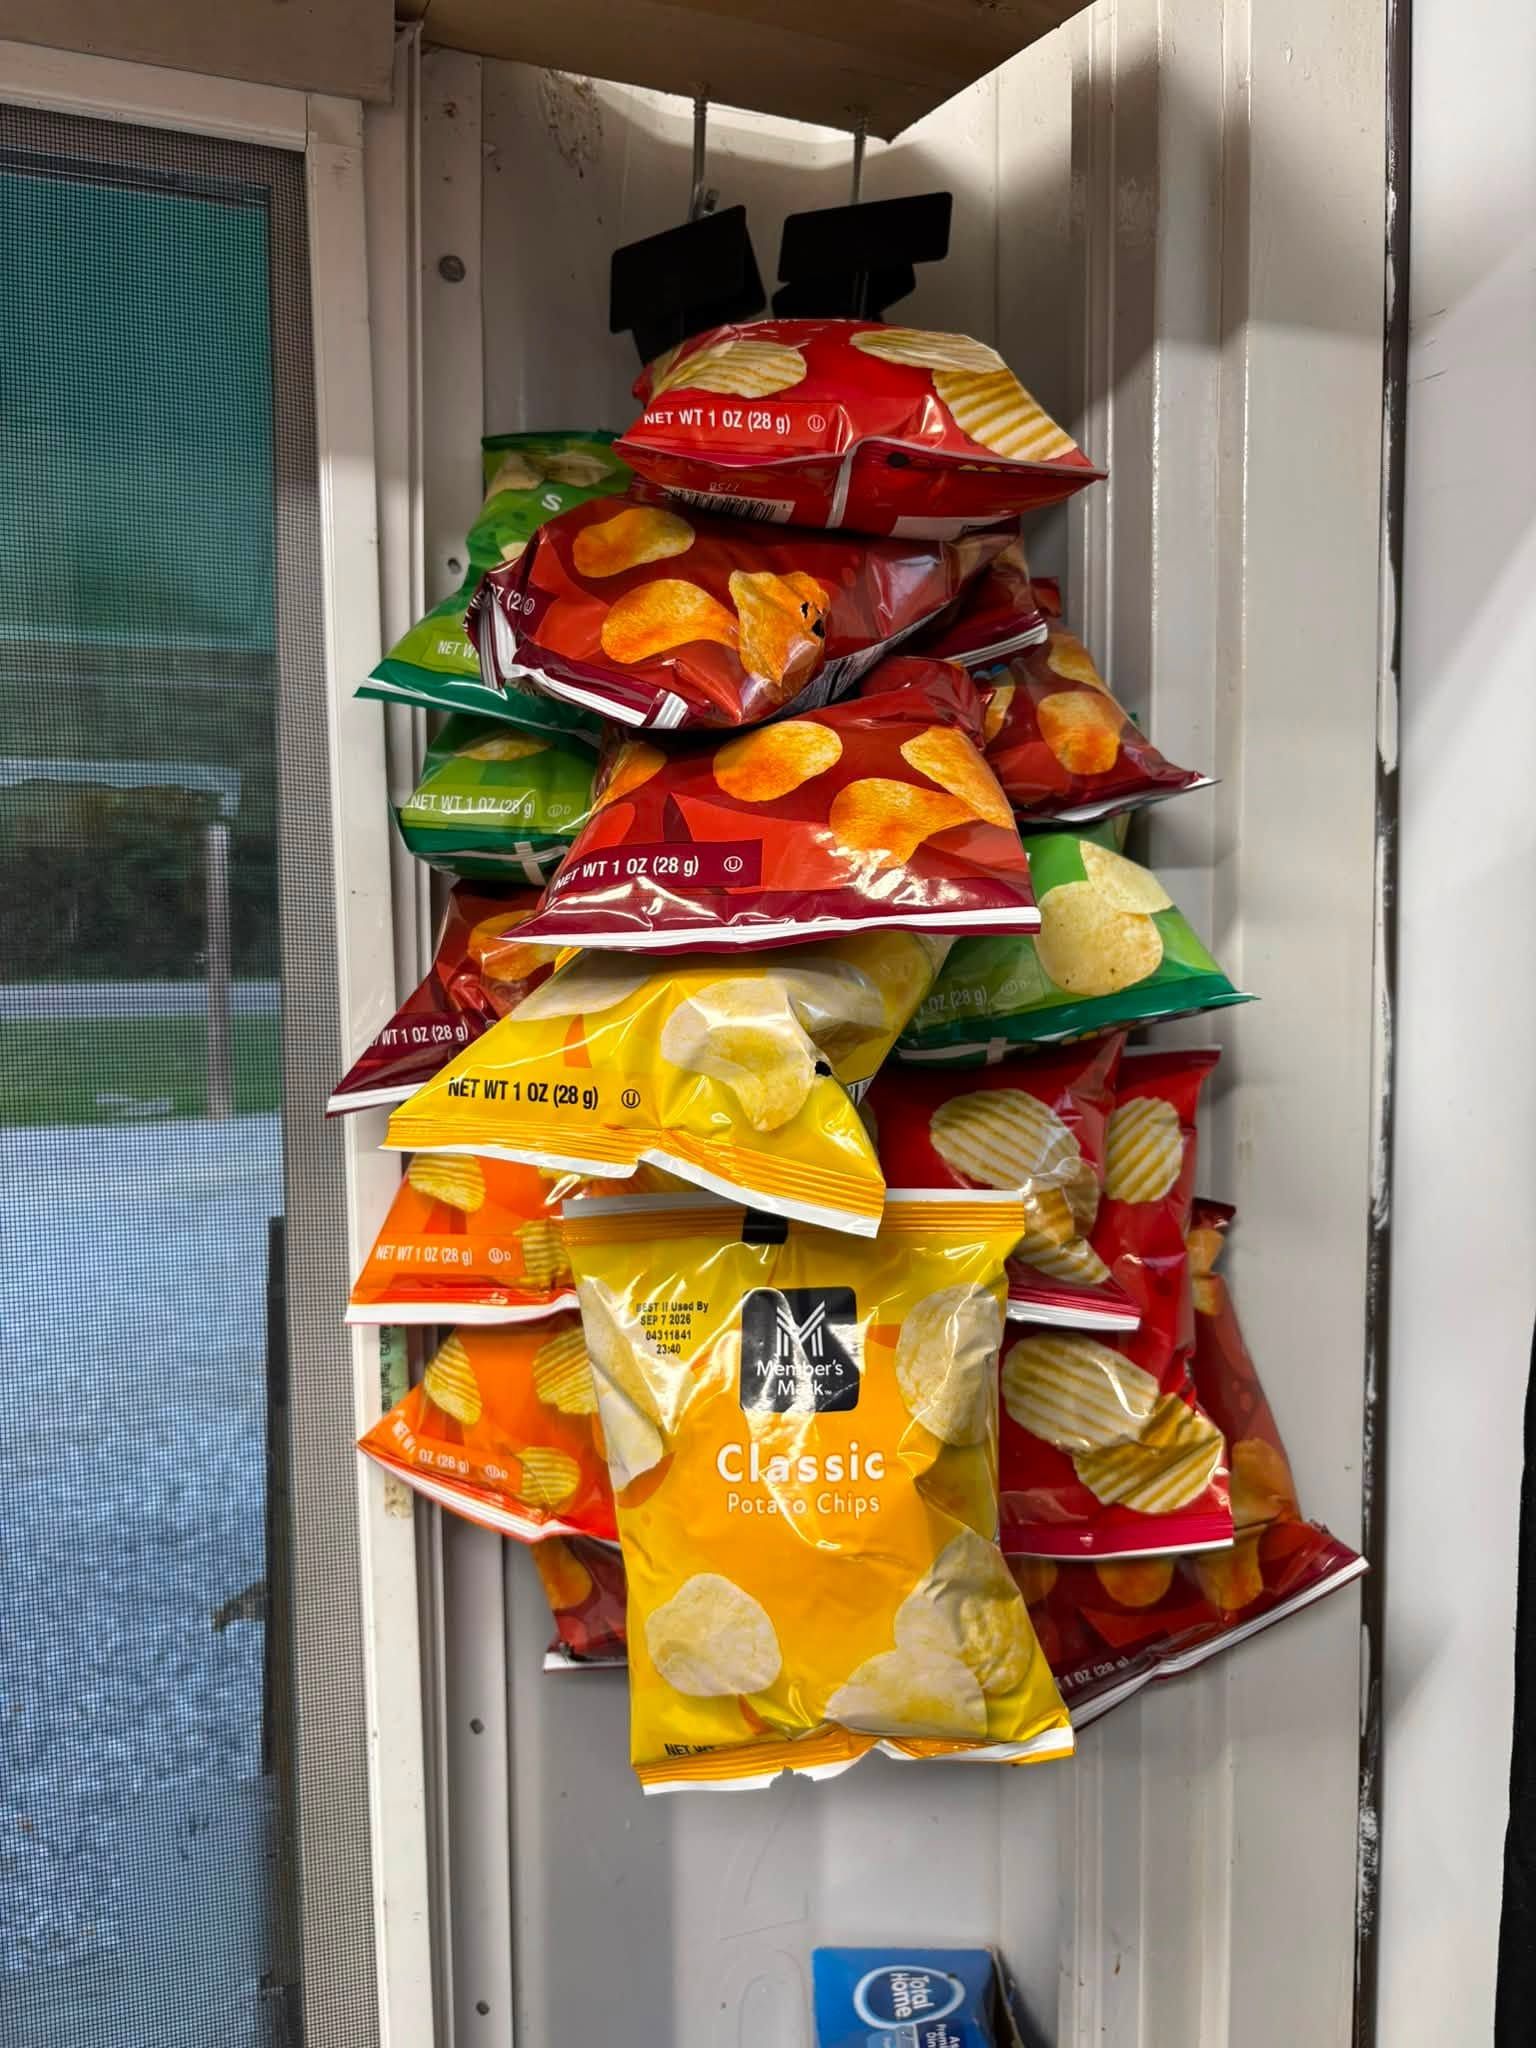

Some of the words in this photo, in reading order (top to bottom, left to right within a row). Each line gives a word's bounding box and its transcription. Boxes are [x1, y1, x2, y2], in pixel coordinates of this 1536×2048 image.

[643, 411, 673, 425] NET
[679, 409, 703, 427] WT
[709, 410, 715, 428] 1
[722, 410, 743, 428] OZ
[748, 411, 772, 432] (28
[776, 414, 791, 435] g)
[438, 639, 461, 655] NET
[410, 794, 437, 809] NET
[442, 794, 463, 811] WT
[467, 796, 473, 811] 1
[479, 796, 496, 812] OZ
[500, 799, 520, 816] (28
[523, 799, 536, 819] g)
[554, 868, 580, 890] NET
[582, 860, 607, 877] WT
[612, 861, 619, 875] 1
[626, 858, 648, 873] OZ
[652, 856, 678, 876] (28
[683, 855, 699, 877] g)
[382, 1029, 398, 1046] WT
[401, 1028, 408, 1044] 1
[412, 1027, 429, 1043] OZ
[432, 1026, 453, 1043] (28
[457, 1024, 469, 1041] g)
[448, 1076, 480, 1097] NET
[484, 1079, 509, 1099] WT
[513, 1081, 520, 1100] 1
[527, 1082, 548, 1102] OZ
[553, 1084, 577, 1108] (28
[583, 1088, 598, 1110] g)
[375, 1245, 396, 1261] NET
[396, 1245, 414, 1261] WT
[415, 1246, 421, 1261] 1
[424, 1246, 438, 1263] OZ
[441, 1247, 459, 1264] (28
[462, 1249, 473, 1267] g)
[671, 1301, 694, 1312] Used
[697, 1300, 709, 1313] By
[640, 1315, 658, 1325] SEP
[661, 1314, 667, 1325] 7
[669, 1313, 691, 1325] 2026
[645, 1329, 692, 1341] 04311841
[656, 1343, 681, 1354] 23:40
[716, 1441, 886, 1483] Classic
[816, 1492, 880, 1519] Chips
[664, 1743, 690, 1757] NET
[890, 1972, 912, 2017] Home
[910, 1975, 935, 2009] Total
